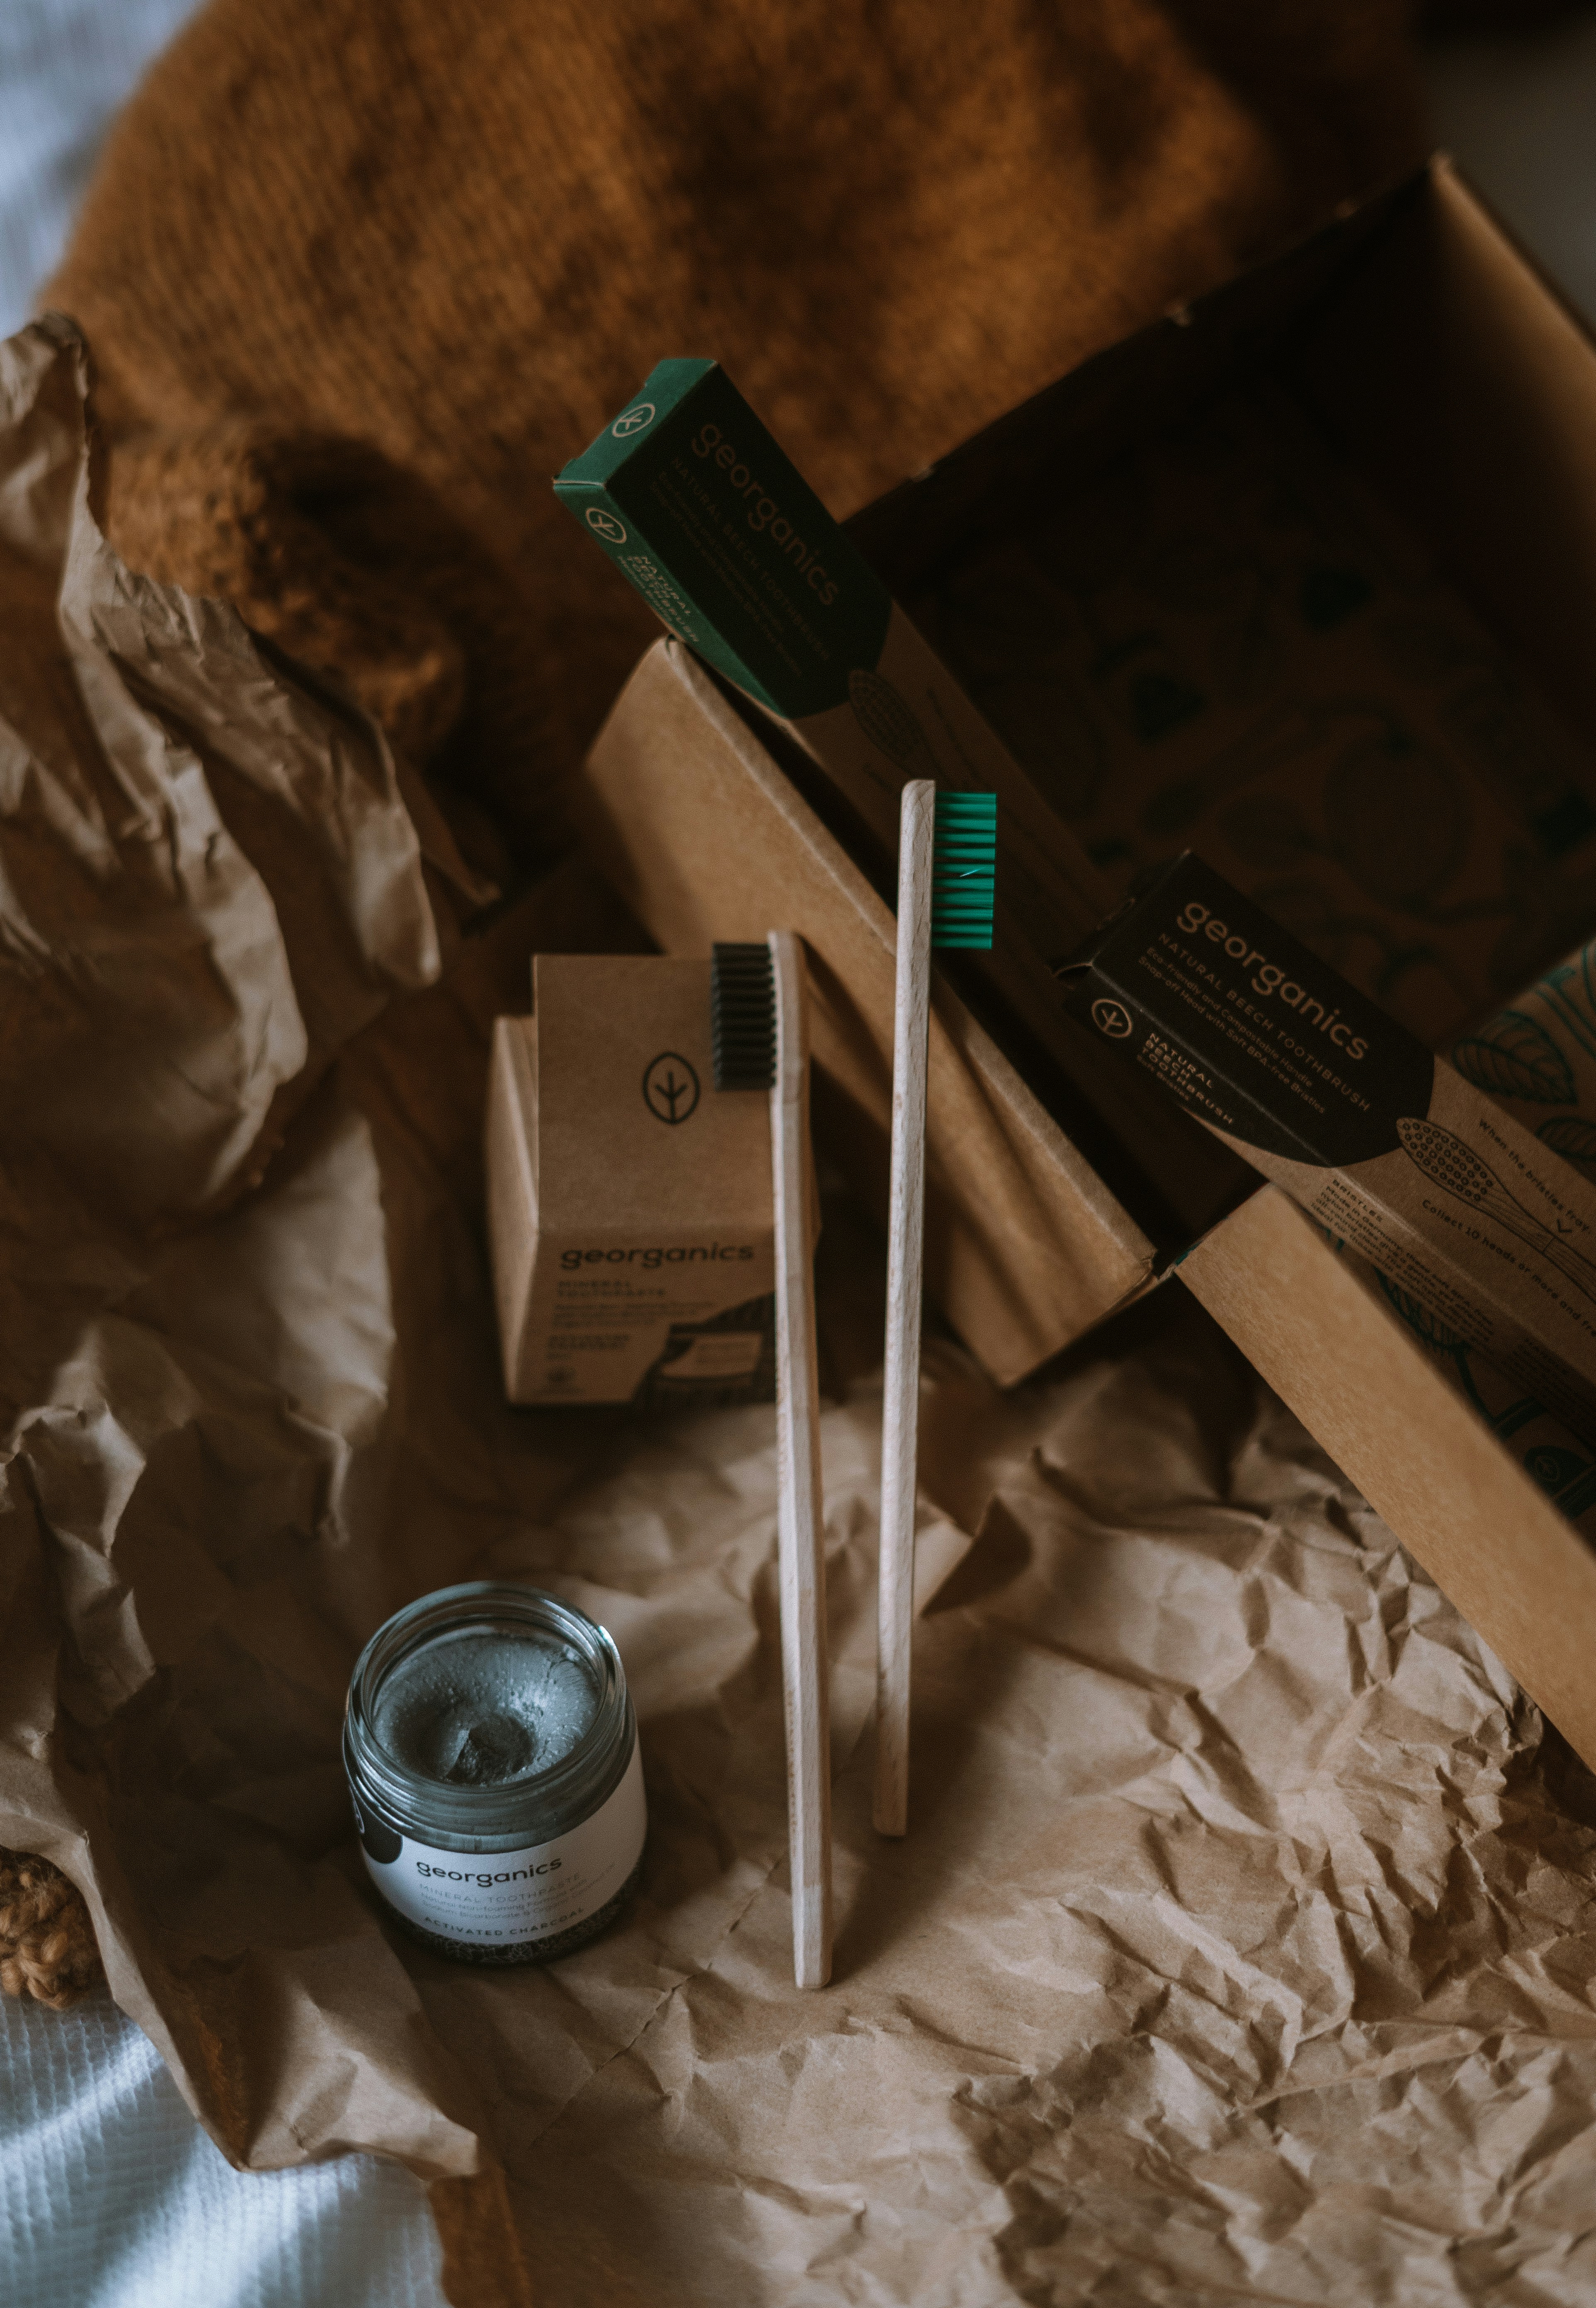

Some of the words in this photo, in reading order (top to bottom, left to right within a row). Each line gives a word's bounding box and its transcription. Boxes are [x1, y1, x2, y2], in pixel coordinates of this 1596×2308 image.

[672, 459, 720, 522] NATURAL
[723, 524, 760, 570] BEECH
[761, 571, 830, 661] TOOTHBRUSH
[692, 424, 839, 605] georganics
[1147, 947, 1201, 994] Eco-friendly
[1202, 994, 1221, 1010] and
[1222, 1009, 1278, 1059] Compostable
[1280, 1058, 1312, 1086] Handle
[1159, 933, 1220, 989] NATURAL
[1227, 990, 1273, 1030] BEECH
[1278, 1031, 1370, 1111] TOOTHBRUSH
[1177, 903, 1368, 1059] georganics
[1139, 956, 1180, 992] Snap-off
[1181, 990, 1205, 1013] Head
[1206, 1013, 1225, 1030] with
[1226, 1029, 1247, 1047] Soft
[1247, 1046, 1290, 1084] BPA-free
[1291, 1083, 1325, 1113] Bristles
[1146, 1039, 1190, 1078] BEECH
[1150, 1033, 1211, 1088] NATURAL
[1143, 1047, 1232, 1123] TOOTHBRUSH
[1478, 1119, 1508, 1150] When
[1508, 1150, 1526, 1171] the
[1525, 1170, 1564, 1211] bristles
[560, 1242, 754, 1270] georganics
[1421, 1199, 1464, 1231] Collect
[1465, 1225, 1481, 1241] 10
[1482, 1236, 1516, 1264] heads
[1517, 1261, 1531, 1274] or
[1531, 1272, 1560, 1301] more
[1560, 1299, 1582, 1322] and
[416, 1858, 562, 1888] georganics
[420, 1883, 481, 1903] MINERAL
[487, 1872, 580, 1903] TOOTHPASTE
[424, 1916, 503, 1937] ACTIVATED
[509, 1907, 584, 1935] CHARCOAL
